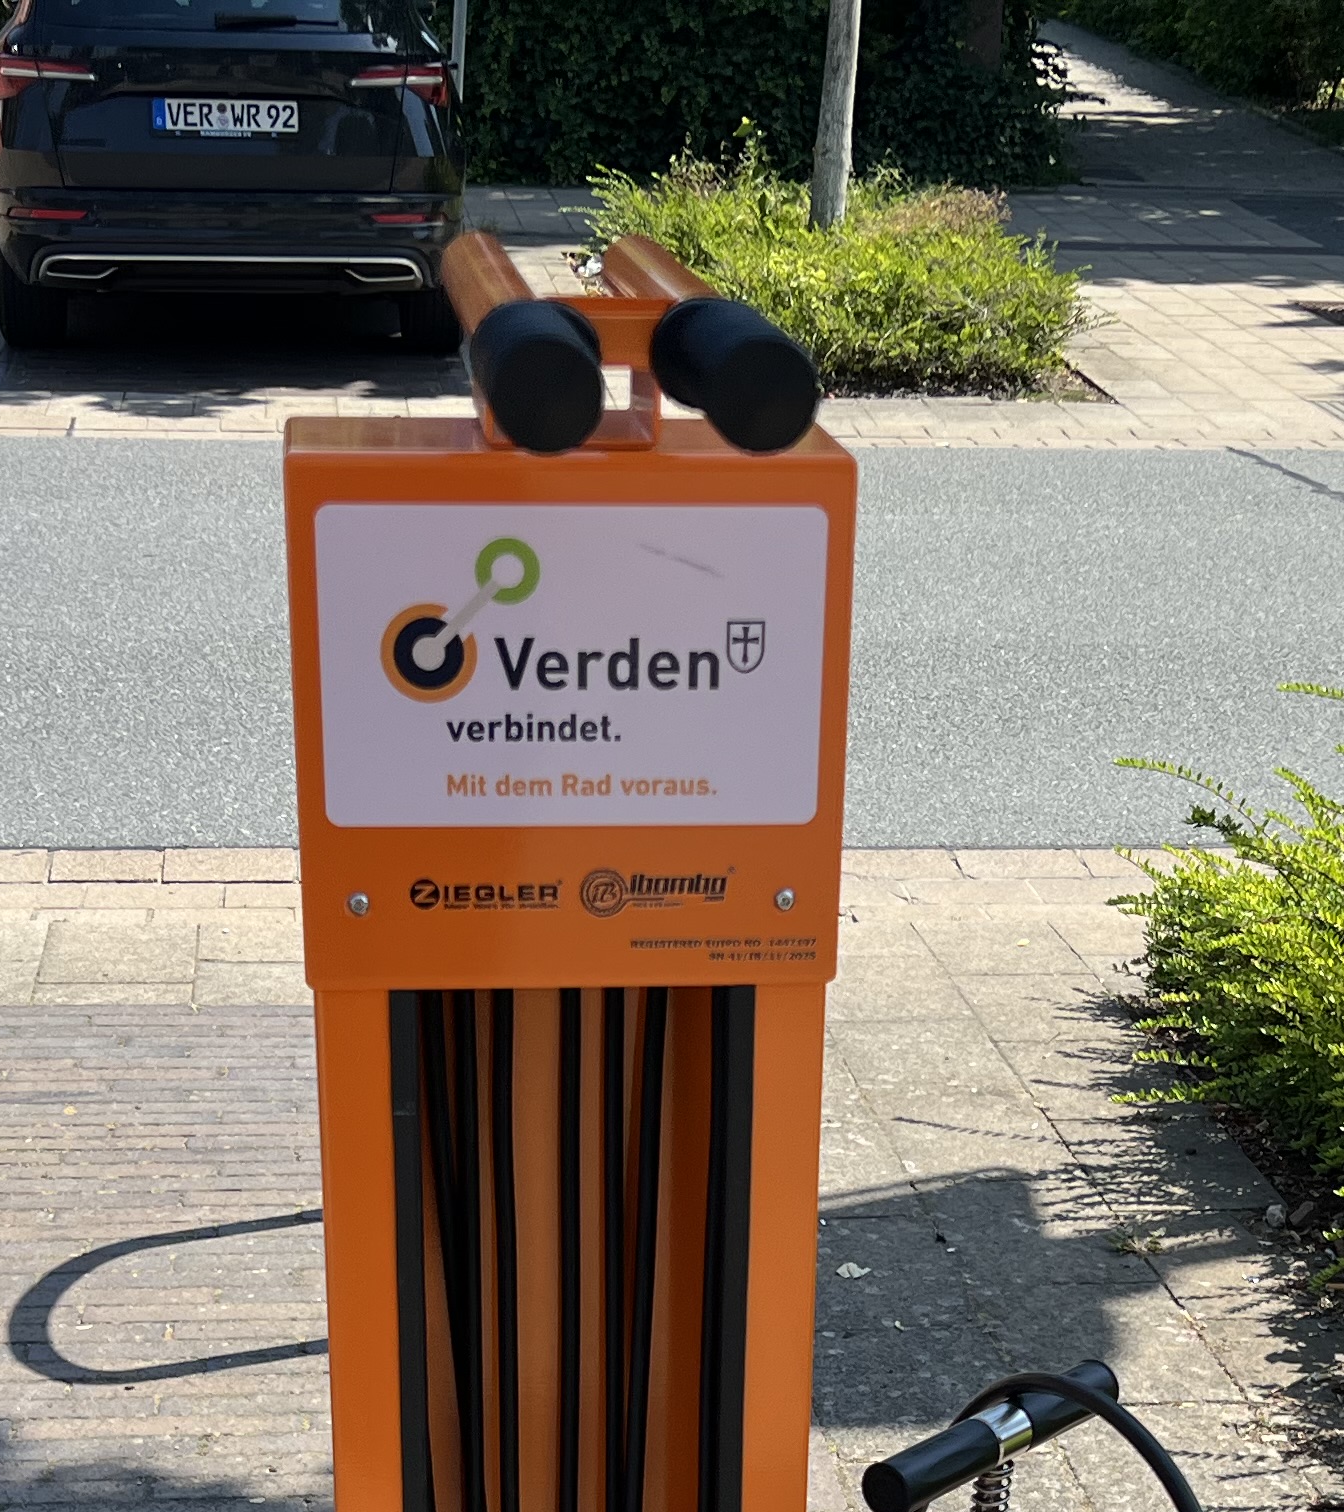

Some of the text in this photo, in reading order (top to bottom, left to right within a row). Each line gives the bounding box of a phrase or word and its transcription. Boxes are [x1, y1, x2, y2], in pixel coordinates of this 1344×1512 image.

[167, 102, 296, 128] VER WR 92
[494, 636, 720, 692] Verden
[446, 713, 622, 743] verbindet.
[446, 773, 719, 798] Mit dem Rad voraus.
[411, 881, 559, 906] ZIEGLER
